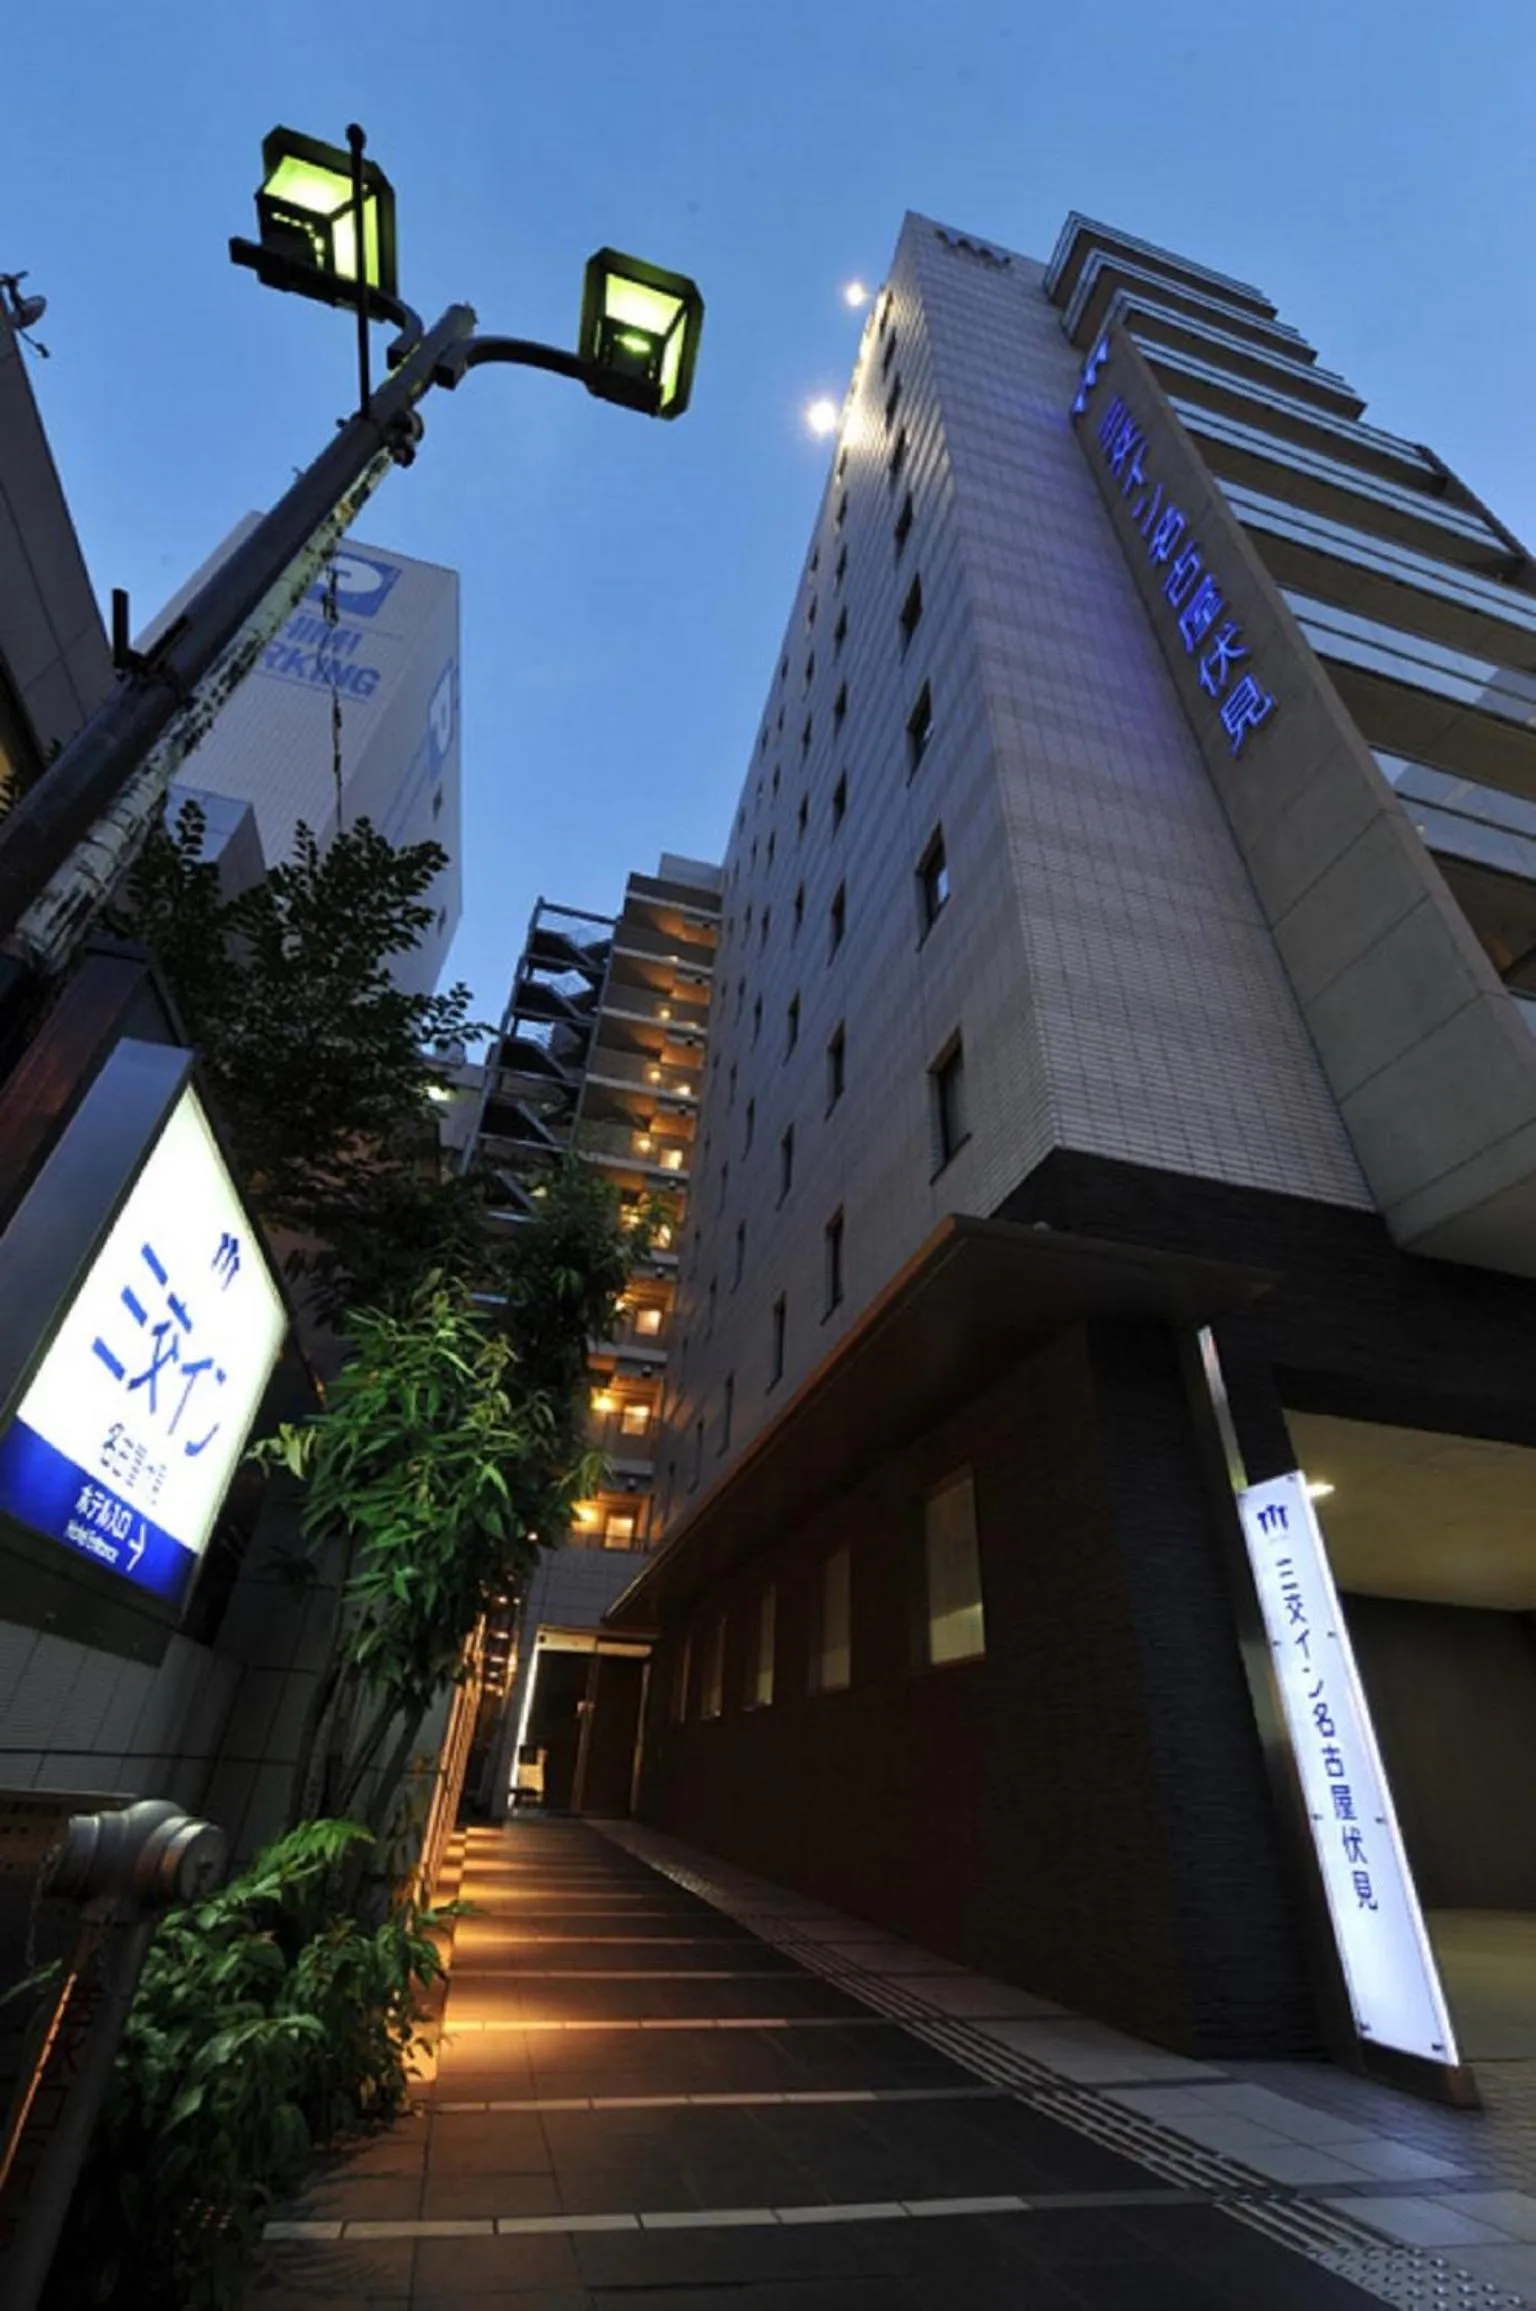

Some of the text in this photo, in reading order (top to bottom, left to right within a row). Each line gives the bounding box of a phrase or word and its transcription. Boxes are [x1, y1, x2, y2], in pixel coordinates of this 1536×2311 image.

[264, 641, 381, 697] RKING
[92, 1242, 226, 1457] 三交イン
[1276, 1558, 1378, 1911] 三交イン名古屋伏見
